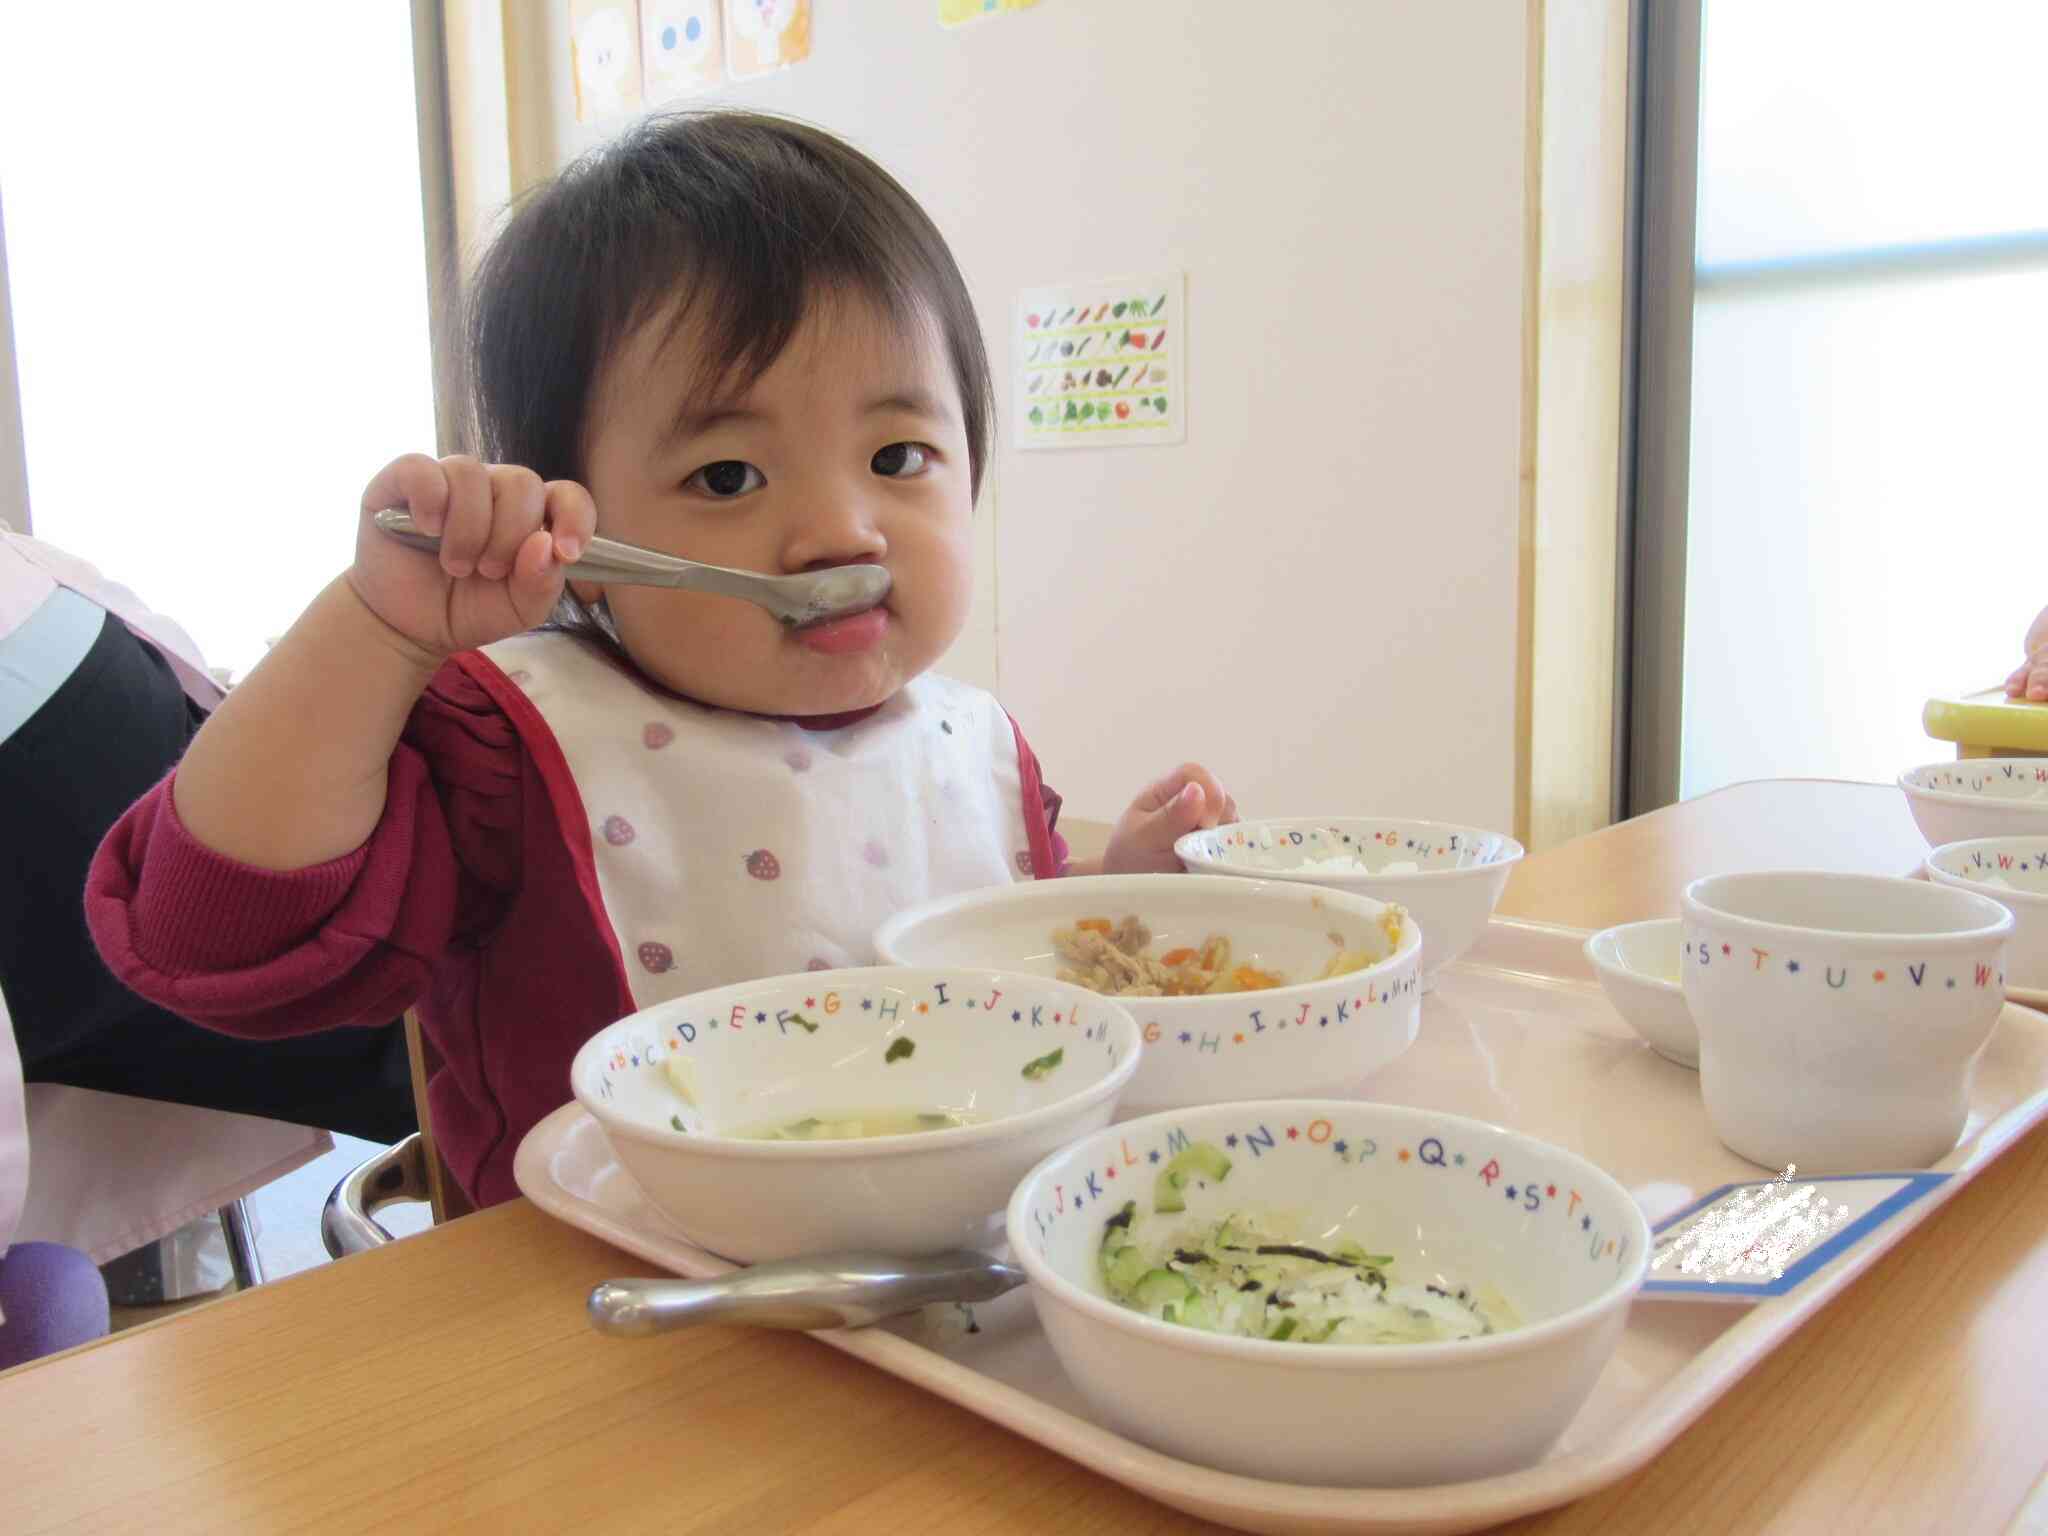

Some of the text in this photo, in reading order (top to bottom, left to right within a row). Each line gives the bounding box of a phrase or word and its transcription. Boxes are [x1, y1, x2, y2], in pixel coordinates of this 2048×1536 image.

[1971, 778, 1983, 792] U
[2002, 764, 2013, 779] V
[1288, 831, 1304, 846] D
[1385, 831, 1398, 847] G
[1450, 836, 1459, 850] I
[1971, 851, 2048, 871] V W X
[1699, 943, 1992, 988] S T U V W
[645, 1044, 658, 1067] C
[677, 1022, 697, 1043] D
[729, 1005, 746, 1029] E
[775, 1009, 791, 1034] F
[824, 991, 841, 1015] G
[879, 997, 899, 1022] H
[934, 983, 951, 1006] I
[983, 989, 1003, 1011] J
[1031, 1004, 1044, 1028] K
[1069, 1001, 1080, 1025] L
[1144, 1022, 1161, 1044] G
[1199, 1032, 1221, 1054] H
[1249, 1010, 1266, 1033] I
[1295, 1003, 1312, 1026] J
[1336, 1000, 1349, 1023] K
[1366, 981, 1377, 1002] L
[1085, 1170, 1103, 1201] K
[1119, 1137, 1138, 1167] L
[1166, 1126, 1193, 1155] M
[1244, 1123, 1275, 1158] N
[1307, 1119, 1333, 1144] O
[1358, 1137, 1377, 1164] P
[1418, 1137, 1447, 1167] Q
[1478, 1158, 1501, 1188] R
[1523, 1184, 1541, 1211] S
[1566, 1189, 1583, 1217] T
